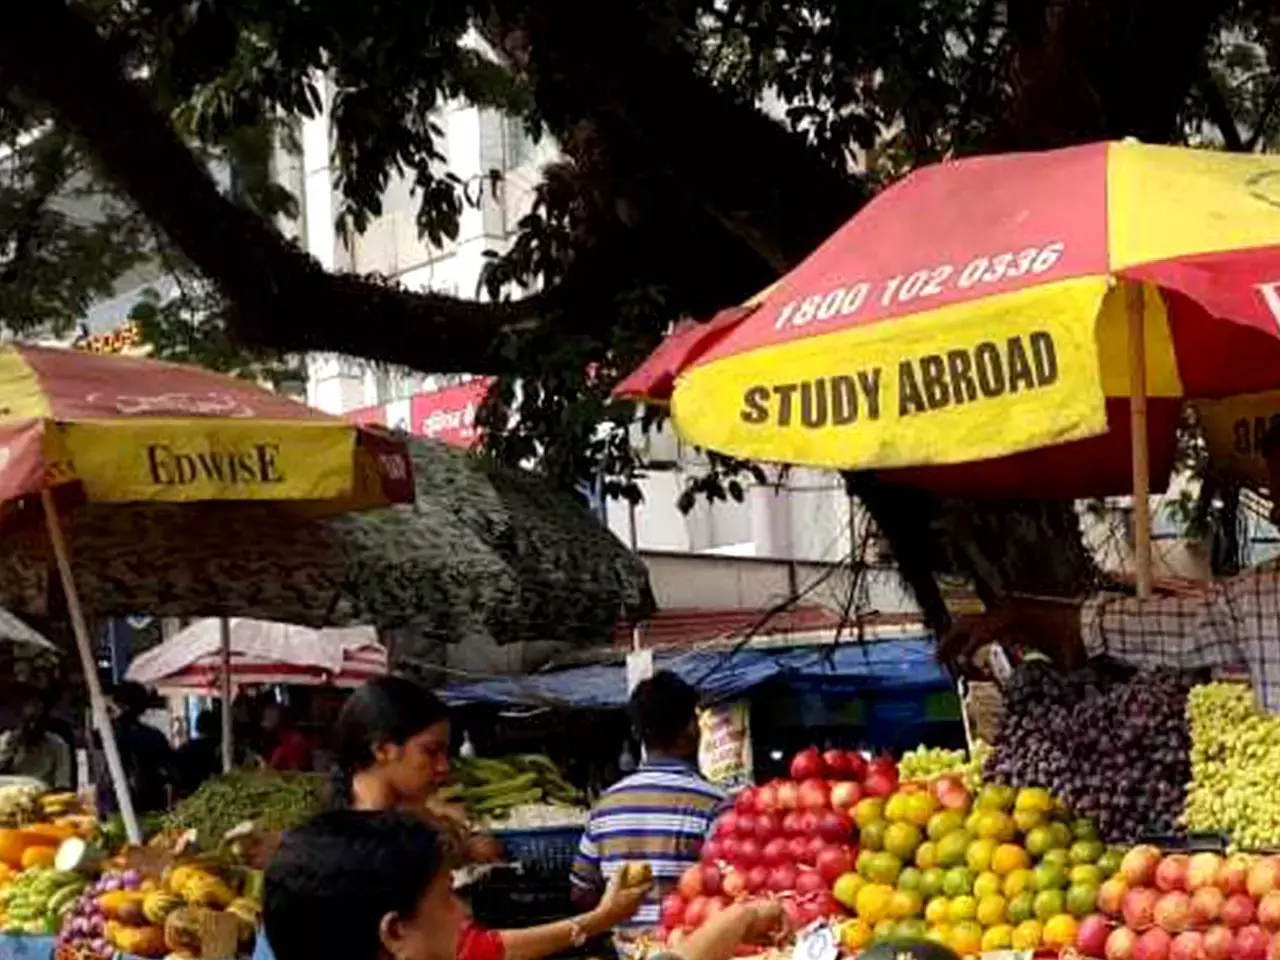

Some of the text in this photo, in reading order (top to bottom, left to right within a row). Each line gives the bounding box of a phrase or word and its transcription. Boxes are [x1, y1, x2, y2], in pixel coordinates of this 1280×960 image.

[774, 242, 1064, 329] 1800 102 0336
[740, 330, 1058, 429] STUDY ABROAD
[147, 442, 285, 485] EDWISE
